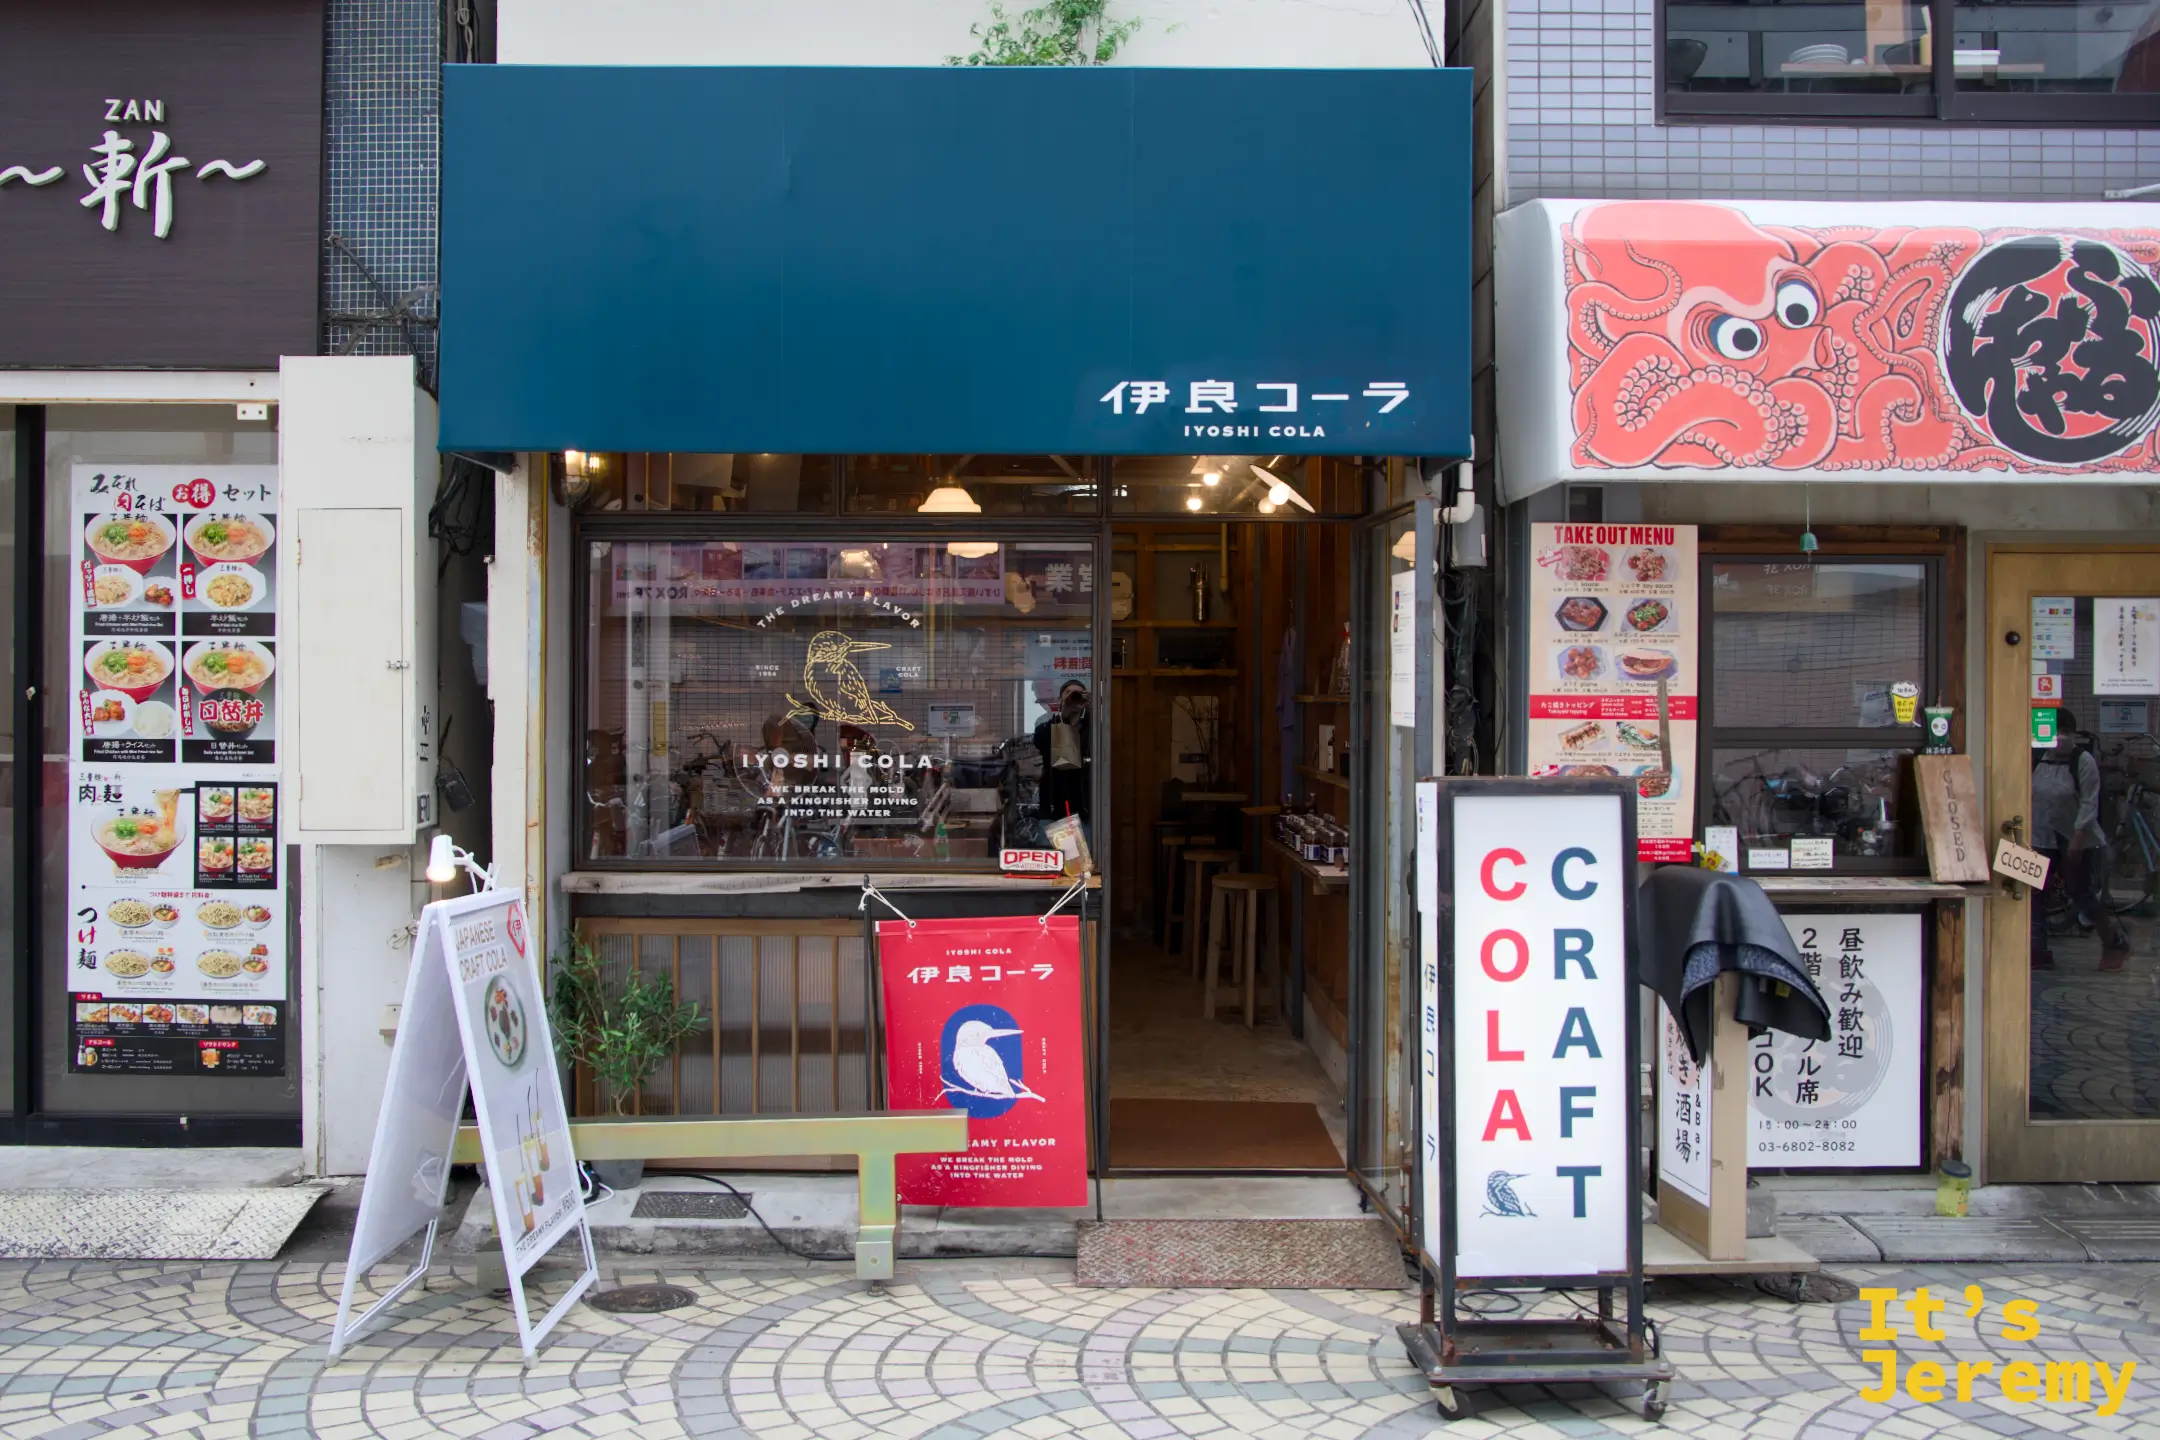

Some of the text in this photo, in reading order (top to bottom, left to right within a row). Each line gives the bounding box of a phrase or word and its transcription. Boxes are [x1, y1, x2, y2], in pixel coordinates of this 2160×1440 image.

[103, 98, 165, 123] ZAN
[1099, 378, 1410, 415] 伊良コーラ
[1184, 425, 1326, 437] IYOSHI COLA
[113, 491, 166, 512] 肉そば
[174, 478, 272, 504] お得 セット
[1554, 525, 1675, 546] TAKE OUT MENU
[756, 591, 922, 630] THE DREAMY FLAVOR
[199, 700, 264, 722] 日替丼
[742, 754, 933, 769] IYOSHI COLA
[771, 785, 905, 794] WE BREAK THE MOLD
[757, 797, 919, 806] AS A KINGFISHER DIVING
[784, 809, 891, 817] INTO THE WATER
[1942, 769, 1966, 863] CLOSED
[1004, 851, 1059, 866] OPEN
[2000, 851, 2043, 879] CLOSED
[77, 907, 98, 970] つけ麺
[455, 919, 495, 952] JAPANESE
[946, 947, 1013, 956] IYOSHI COLA
[459, 947, 508, 982] CRAFT COLA
[907, 963, 1056, 984] 伊良コーラ
[1479, 846, 1533, 1142] COLA
[1838, 927, 1865, 1060] 昼飲み歓迎
[1550, 845, 1603, 1219] CRAFT
[1004, 1137, 1057, 1147] FLAVOR
[1758, 1141, 1856, 1152] 03-6802-8082
